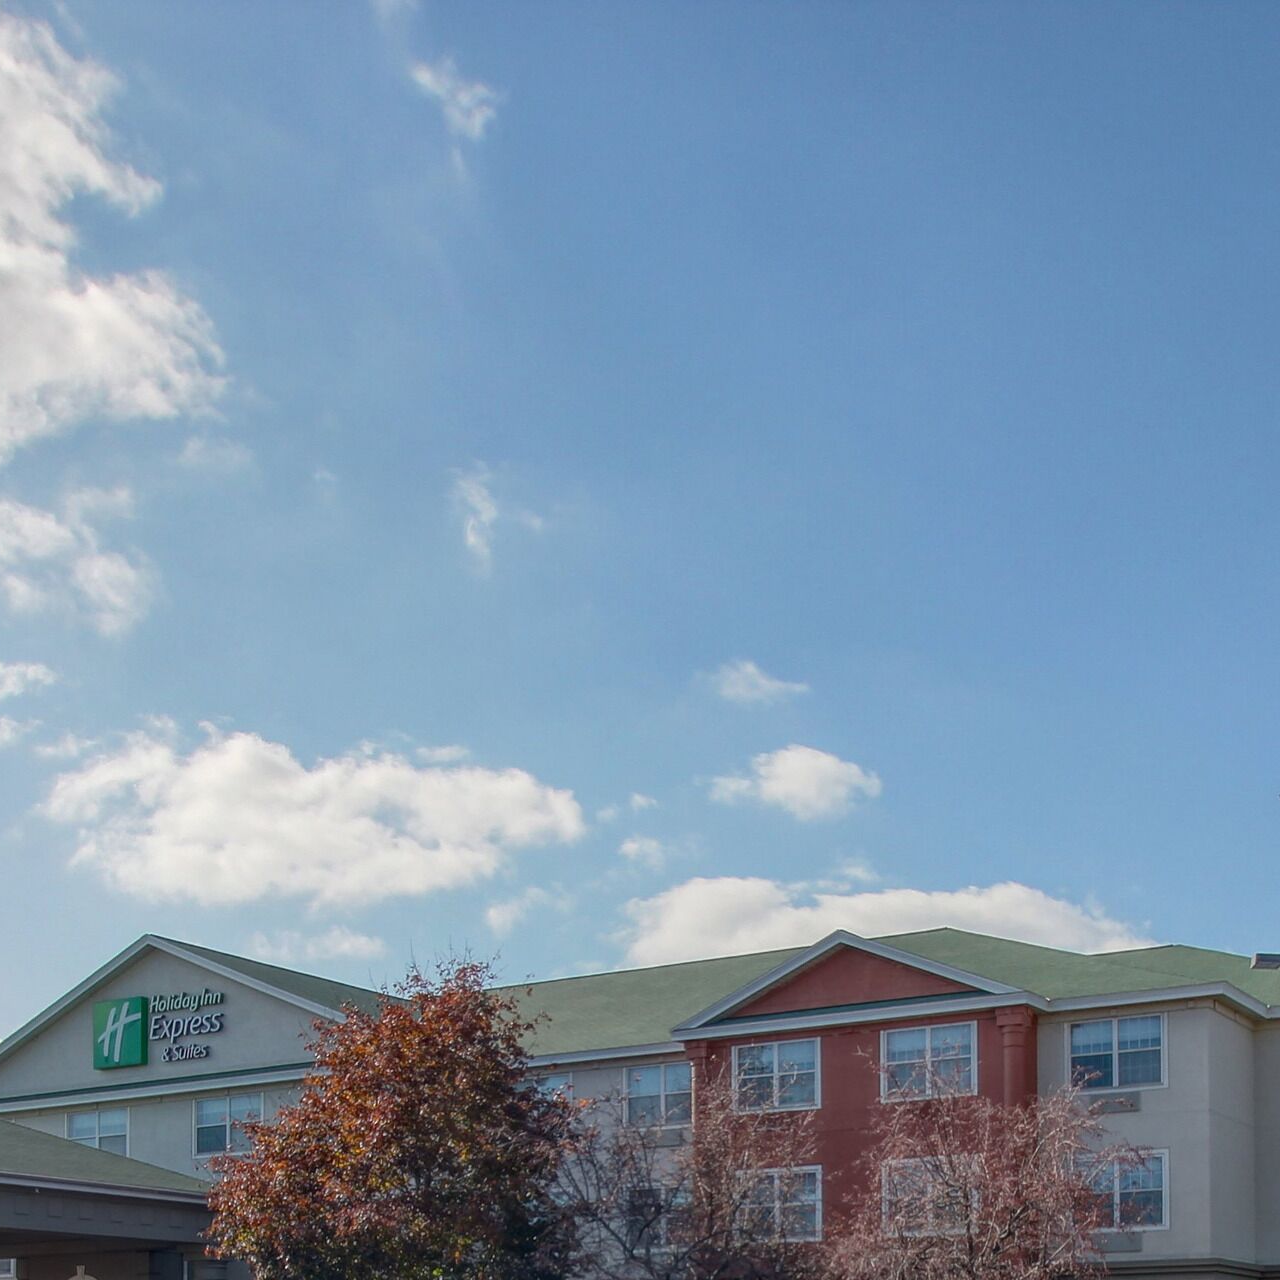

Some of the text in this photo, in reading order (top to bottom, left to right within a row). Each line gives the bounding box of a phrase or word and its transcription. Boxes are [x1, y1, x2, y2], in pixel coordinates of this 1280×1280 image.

[149, 988, 223, 1014] Holiday Inn
[149, 1012, 223, 1043] Express
[161, 1044, 210, 1062] & Suites
